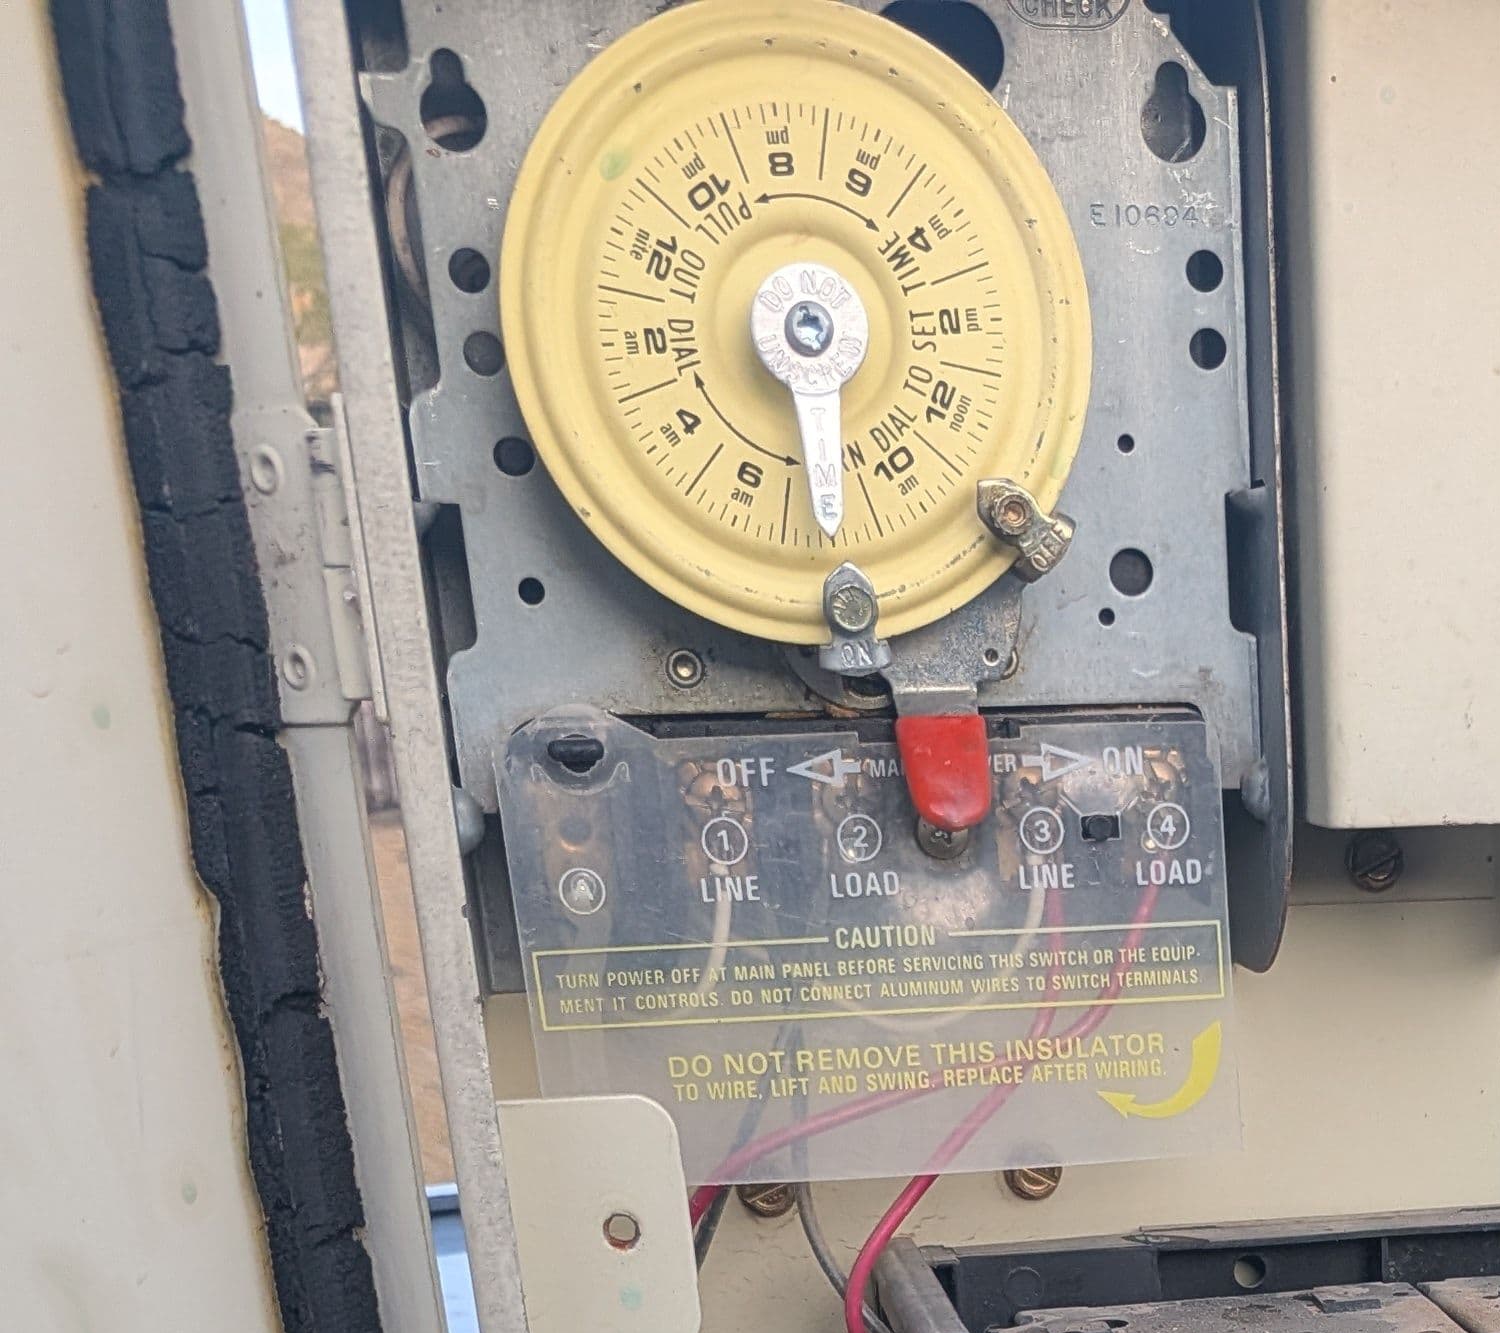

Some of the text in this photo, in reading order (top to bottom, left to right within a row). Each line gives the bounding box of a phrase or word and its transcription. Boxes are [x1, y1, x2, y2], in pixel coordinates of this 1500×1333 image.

[766, 126, 790, 145] pm
[681, 152, 706, 180] pm
[768, 152, 795, 176] 8
[856, 149, 881, 171] pm
[688, 174, 731, 211] 10
[845, 168, 872, 197] 6
[907, 226, 933, 253] 4
[928, 214, 952, 240] pm
[630, 228, 650, 260] nite
[646, 236, 678, 281] 12
[877, 231, 926, 297] TIME
[667, 192, 753, 376] PULL OUT DIAL
[758, 270, 852, 312] DO NOT
[909, 310, 937, 352] SET
[939, 308, 961, 335] 2
[965, 308, 983, 332] pm
[624, 331, 640, 355] am
[643, 327, 667, 355] 2
[903, 365, 933, 397] TO
[926, 380, 957, 424] 12
[949, 395, 972, 432] noon
[659, 423, 682, 448] am
[676, 408, 702, 435] 4
[869, 404, 918, 453] DIAL
[737, 461, 764, 489] 6
[810, 407, 838, 519] TIME
[874, 446, 915, 482] 10
[731, 487, 754, 508] am
[898, 474, 920, 497] am
[841, 640, 874, 668] ON
[717, 758, 775, 787] OFF
[1103, 746, 1143, 776] ON
[853, 825, 868, 848] 2
[1034, 820, 1050, 842] 3
[1160, 815, 1176, 837] 4
[717, 830, 731, 851] 1
[831, 871, 899, 898] LOAD
[1019, 863, 1075, 890] LINE
[1136, 858, 1202, 886] LOAD
[701, 875, 760, 903] LINE
[836, 925, 935, 949] CAUTION
[556, 945, 1201, 990] TURN POWER OFF AT MAIN PANEL BEFORE SERVICING THIS SWITCH OR THE EQUIP-
[559, 968, 1202, 1014] MENT IT CONTROLS. DO NOT CONNECT ALUMINUM WIRES TO SWITCH TERMINALS.
[668, 1032, 1165, 1078] DO NOT REMOVE THIS INSULATOR
[673, 1058, 1167, 1102] TO WIRE, LIFT AND SWING. REPLACE AFTER WIRING.
